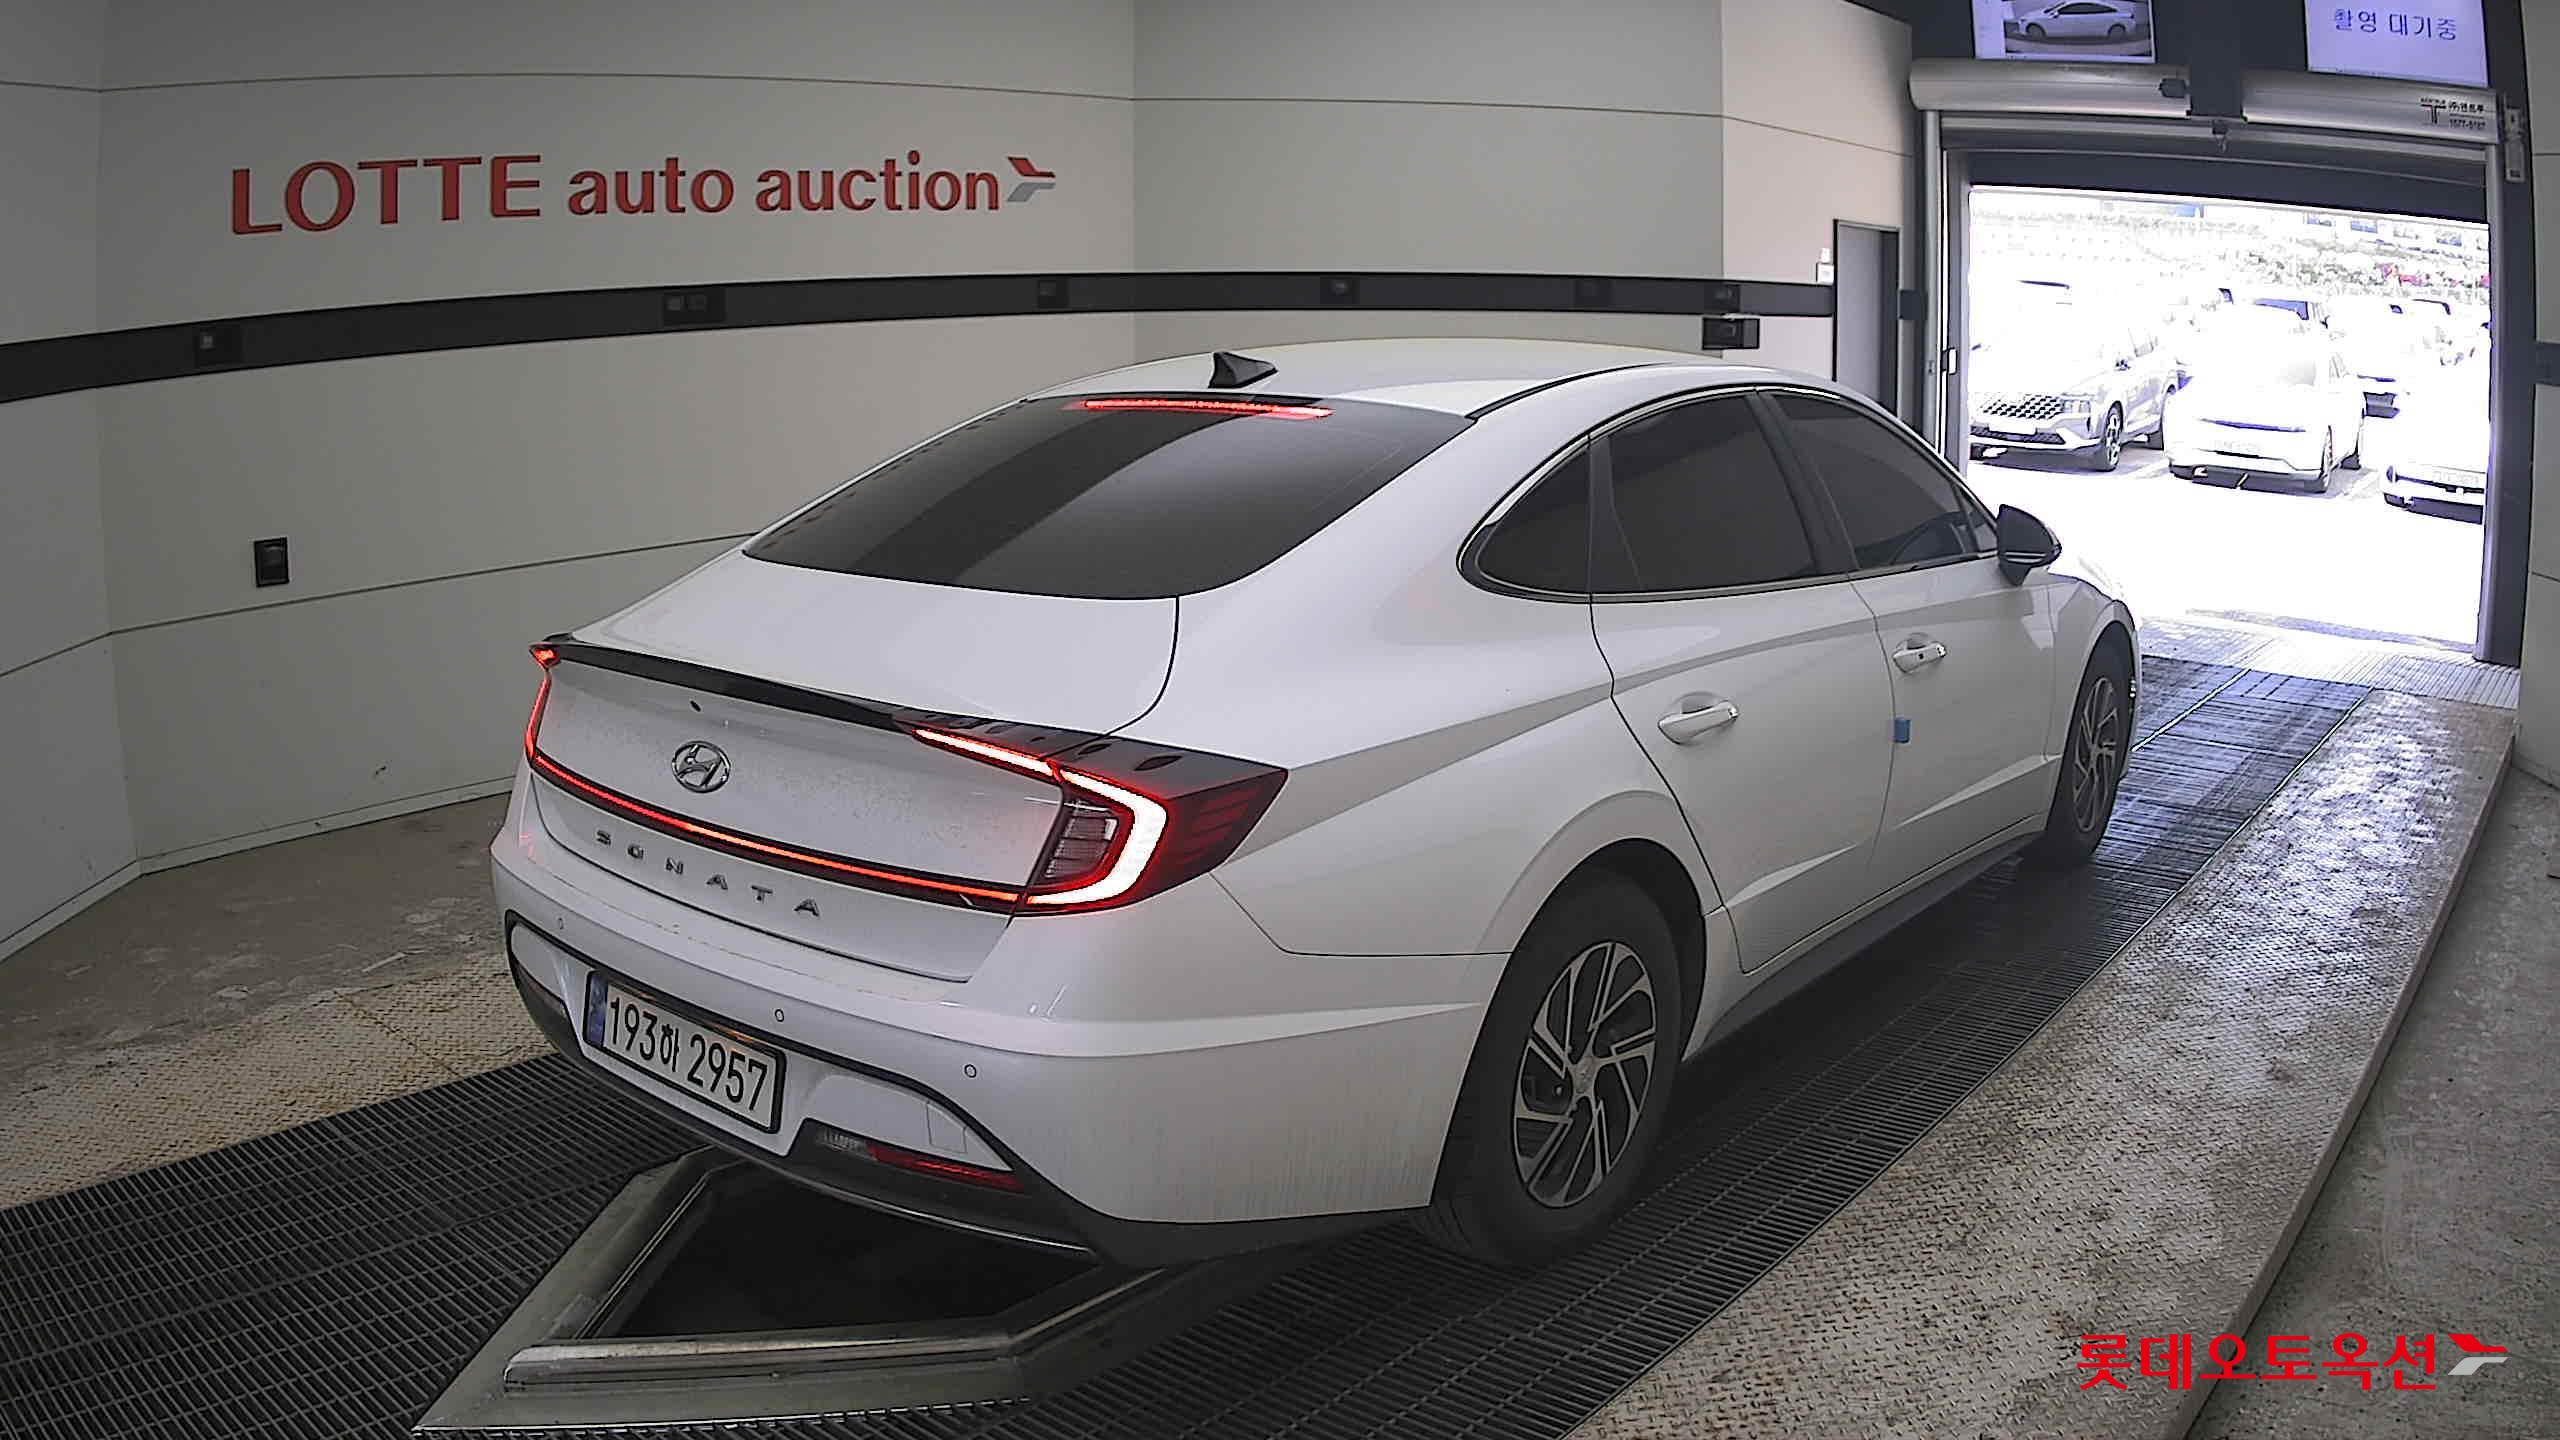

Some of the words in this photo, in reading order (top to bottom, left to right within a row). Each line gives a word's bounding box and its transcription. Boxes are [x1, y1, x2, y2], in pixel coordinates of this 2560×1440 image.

[2335, 8, 2377, 33] 촬영
[2388, 13, 2457, 41] 대기중
[232, 154, 542, 235] LOTTE
[568, 156, 735, 216] auto
[755, 149, 1001, 213] auction
[595, 829, 821, 918] SONATA
[610, 996, 680, 1073] 193하
[686, 1033, 768, 1112] 2957
